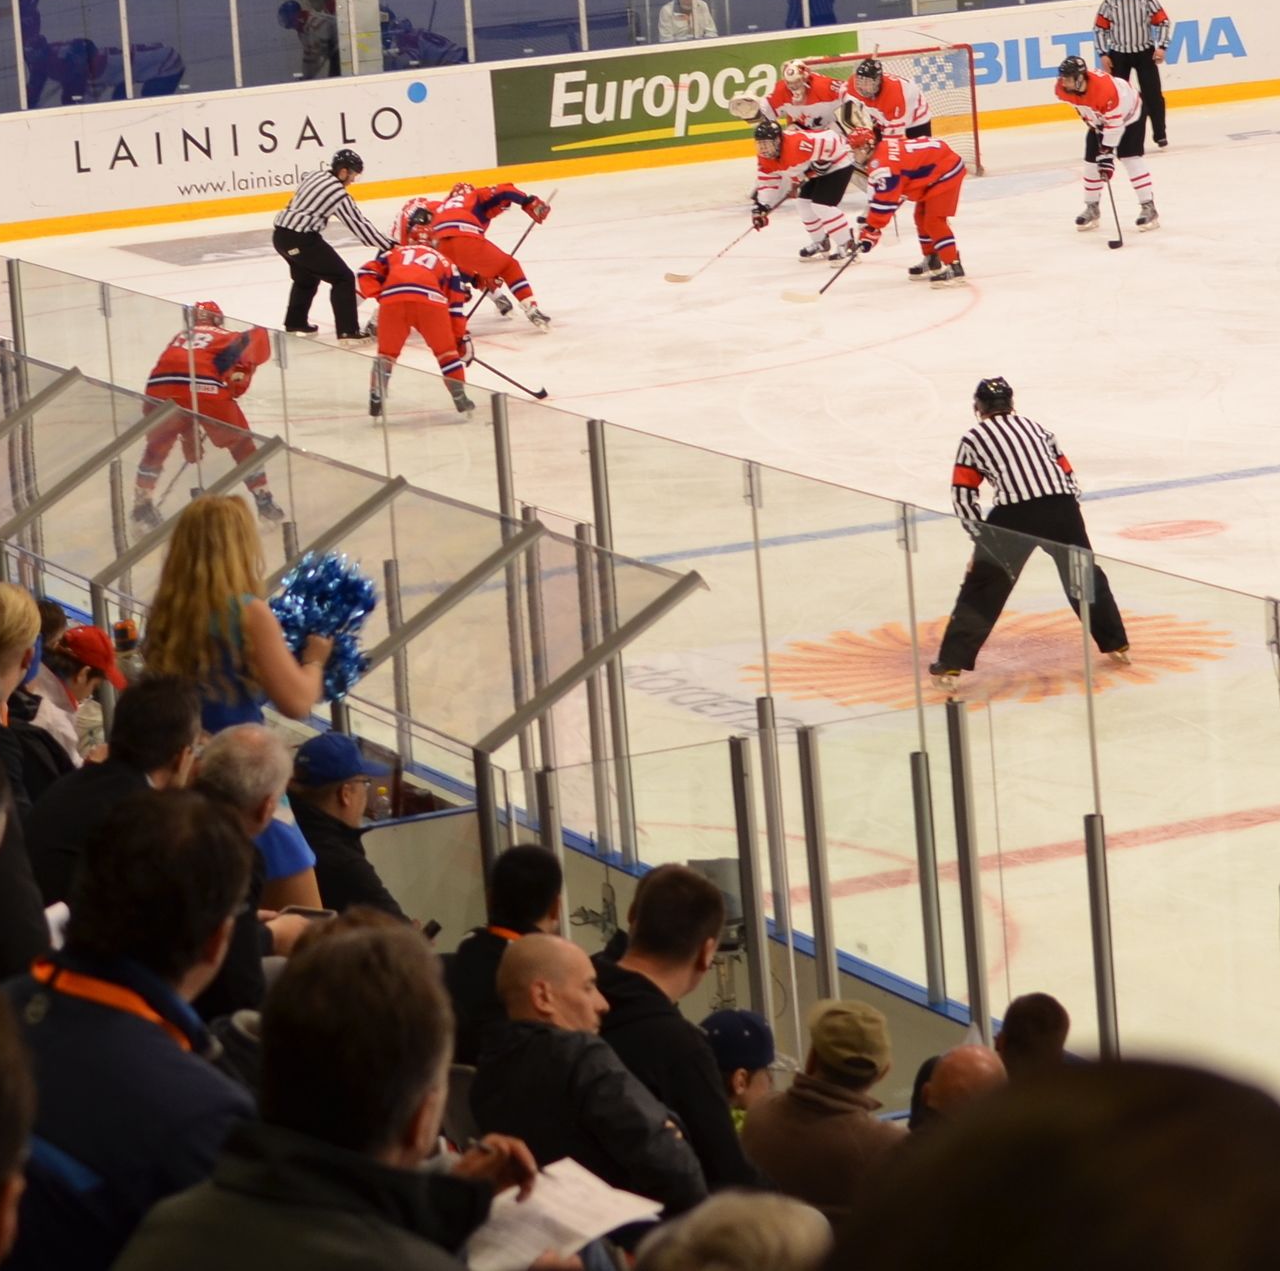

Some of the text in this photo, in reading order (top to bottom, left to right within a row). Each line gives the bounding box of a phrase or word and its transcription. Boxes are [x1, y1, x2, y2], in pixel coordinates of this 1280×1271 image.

[968, 16, 1247, 85] BILTMA
[550, 63, 778, 138] Europca
[75, 106, 403, 174] LAINISALO
[400, 248, 438, 270] 14
